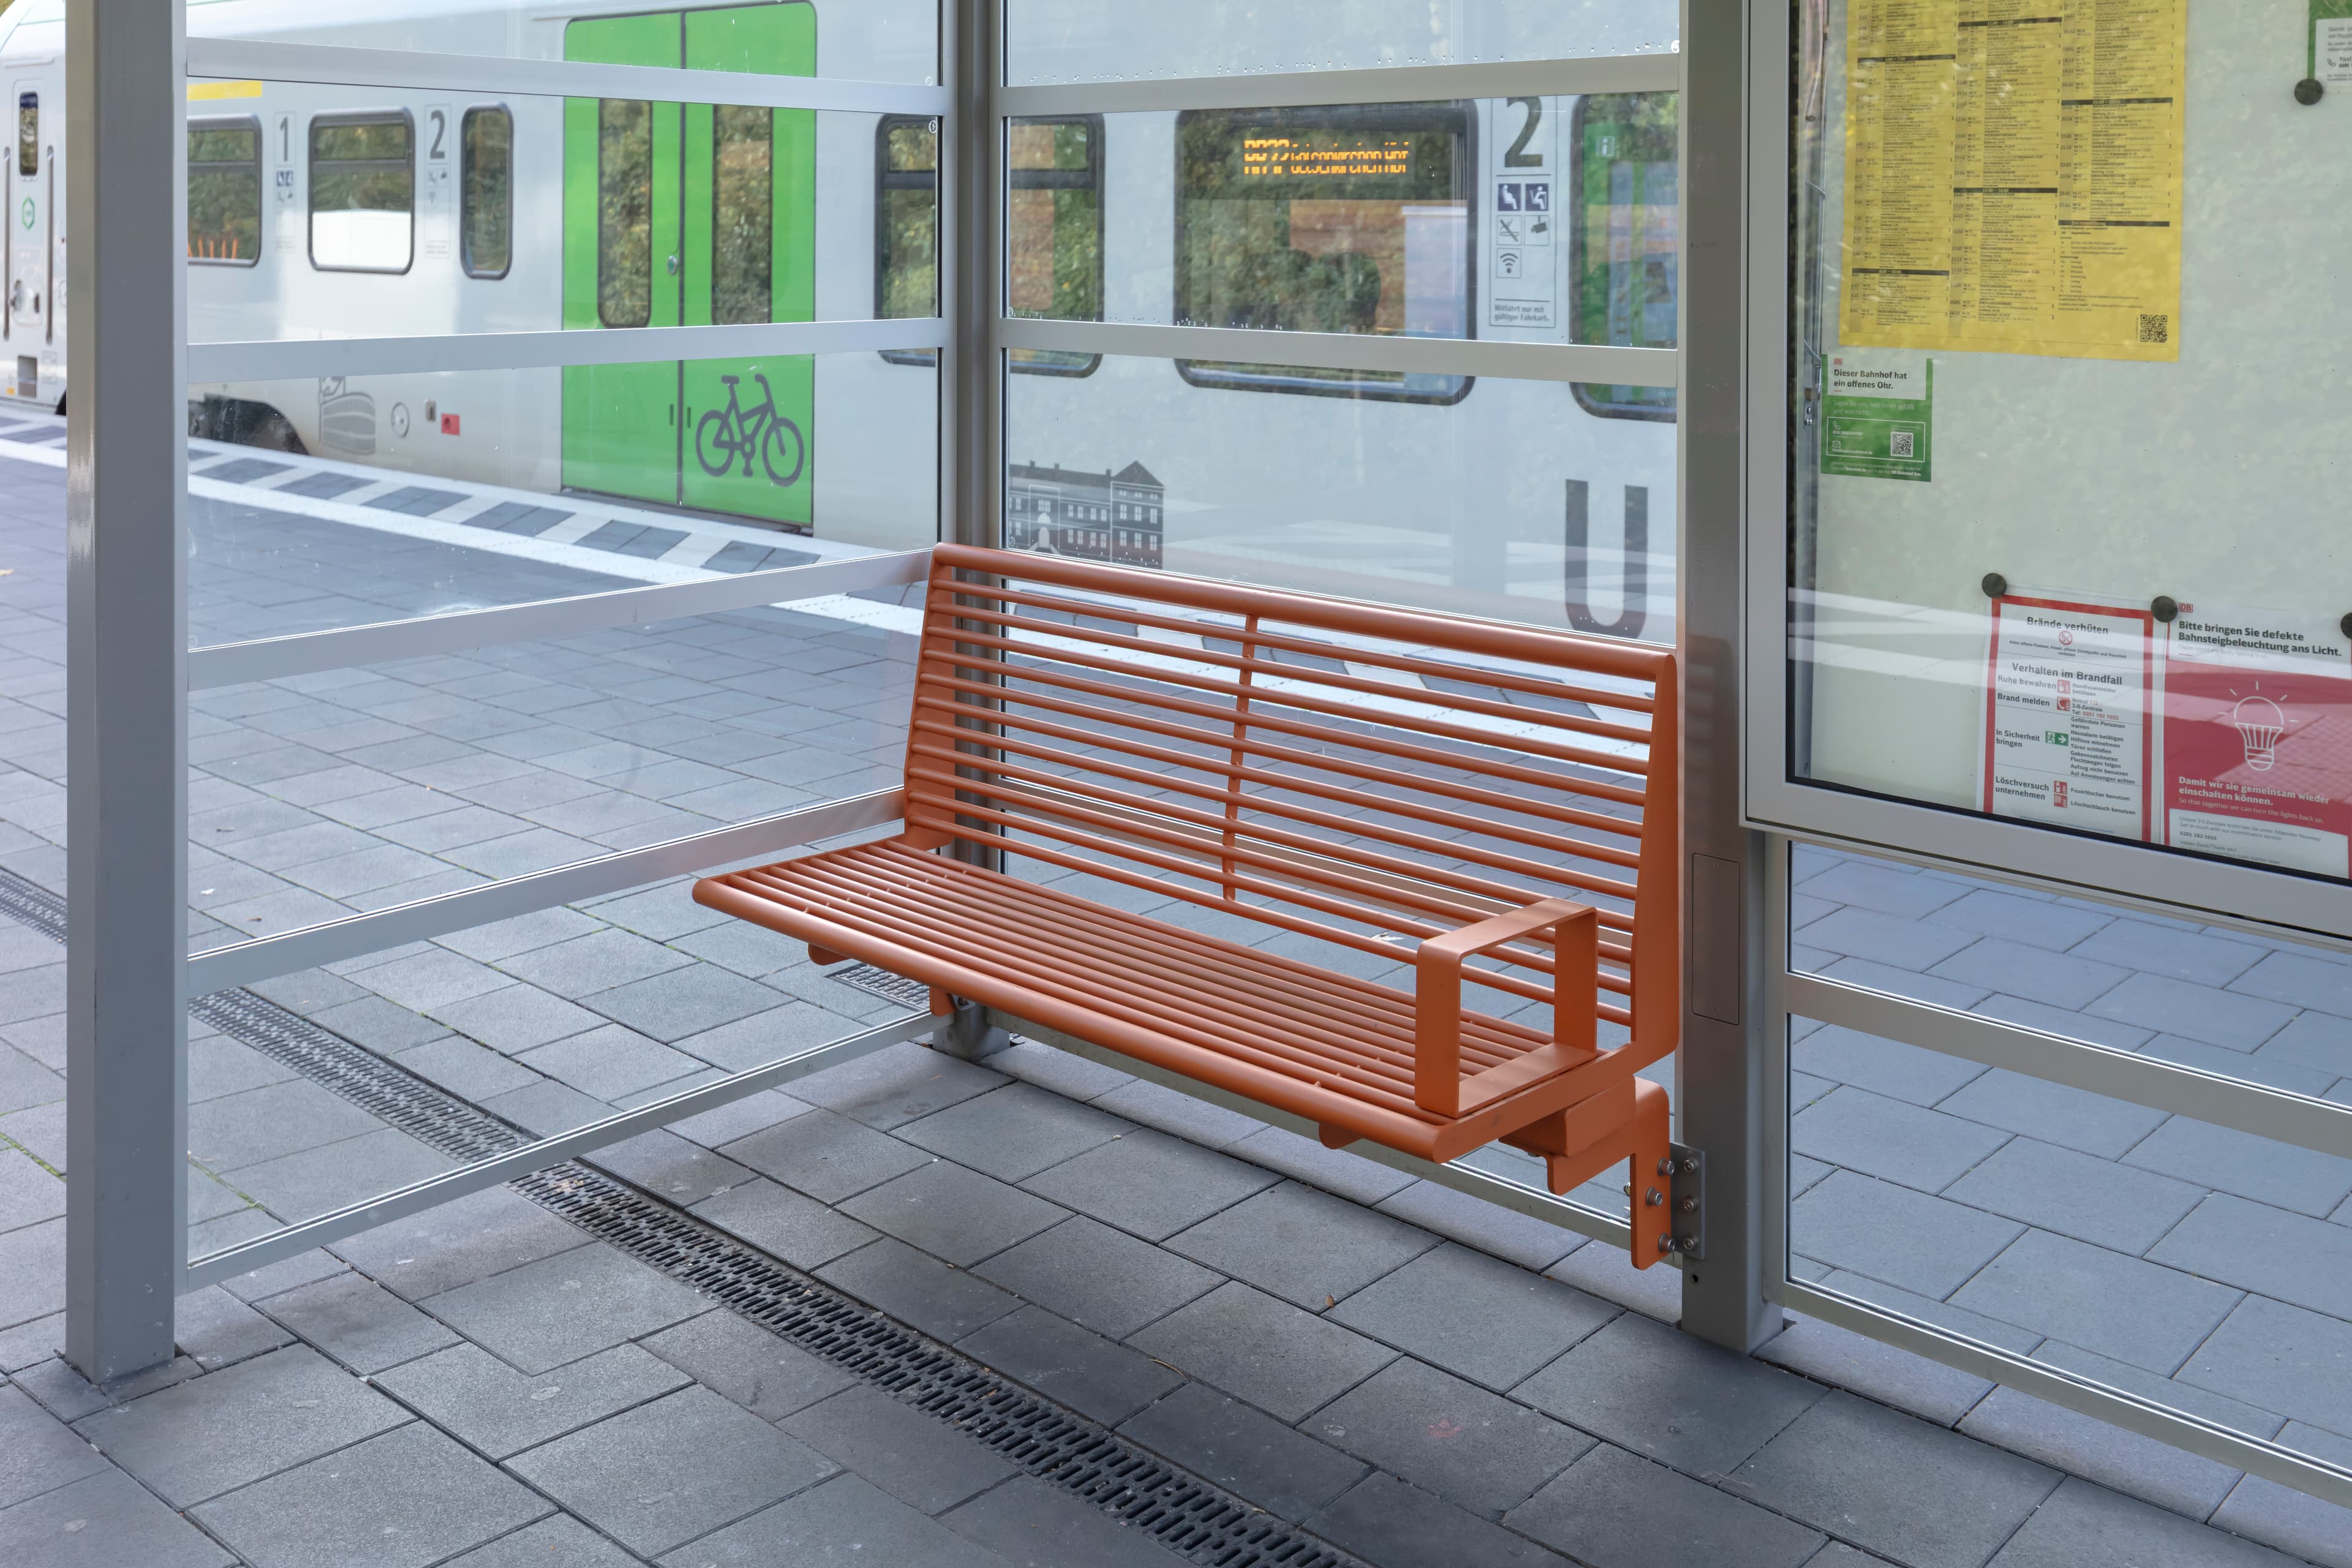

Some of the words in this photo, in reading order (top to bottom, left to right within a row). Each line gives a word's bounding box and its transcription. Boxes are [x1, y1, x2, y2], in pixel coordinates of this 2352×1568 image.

[429, 110, 445, 159] 2
[1505, 96, 1544, 167] 2
[280, 116, 288, 162] 1
[1494, 312, 1520, 322] gültiger
[1834, 369, 1858, 377] Dieser
[1860, 370, 1893, 379] Bahnhof
[1847, 380, 1875, 388] offenes
[1877, 381, 1894, 390] Ohr.
[1565, 479, 1648, 639] U
[2180, 603, 2193, 612] DB
[2027, 616, 2062, 629] Brände
[2064, 622, 2108, 635] verhüten
[2179, 620, 2203, 631] Bitte
[2205, 623, 2242, 636] bringen
[2245, 628, 2260, 637] Sie
[2263, 630, 2304, 641] defekte
[2179, 632, 2289, 654] Bahnsteigbeleuchtung
[2291, 644, 2310, 653] ans
[2312, 646, 2342, 657] Licht.
[2012, 662, 2059, 677] Verhalten
[2062, 669, 2073, 679] im
[2076, 671, 2122, 685] Brandfall
[1998, 675, 2018, 684] Ruhe
[2019, 677, 2057, 689] bewahren
[2073, 683, 2116, 693] Handfeuermelder
[1998, 693, 2020, 703] Brand
[2022, 696, 2050, 706] melden
[2071, 717, 2099, 725] Gefährdete
[2004, 730, 2040, 741] Sicherheit
[1996, 738, 2022, 748] bringen
[2070, 750, 2118, 762] Gekennzeichneten
[2070, 756, 2103, 766] Fluchtwegen
[1996, 776, 2049, 791] Löschversuch
[2081, 772, 2116, 782] Anweisungen
[1996, 787, 2046, 800] unternehmen
[2071, 788, 2105, 797] Feuerlöscher
[2106, 792, 2130, 801] benutzen
[2179, 776, 2206, 787] Damit
[2209, 778, 2223, 789] wir
[2226, 782, 2239, 791] sie
[2241, 786, 2296, 799] gemeinsam
[2298, 791, 2329, 804] wieder
[2179, 788, 2233, 801] einschalten
[2235, 794, 2274, 805] können.
[2071, 801, 2110, 812] Löschschlauch
[2111, 805, 2136, 815] benutzen
